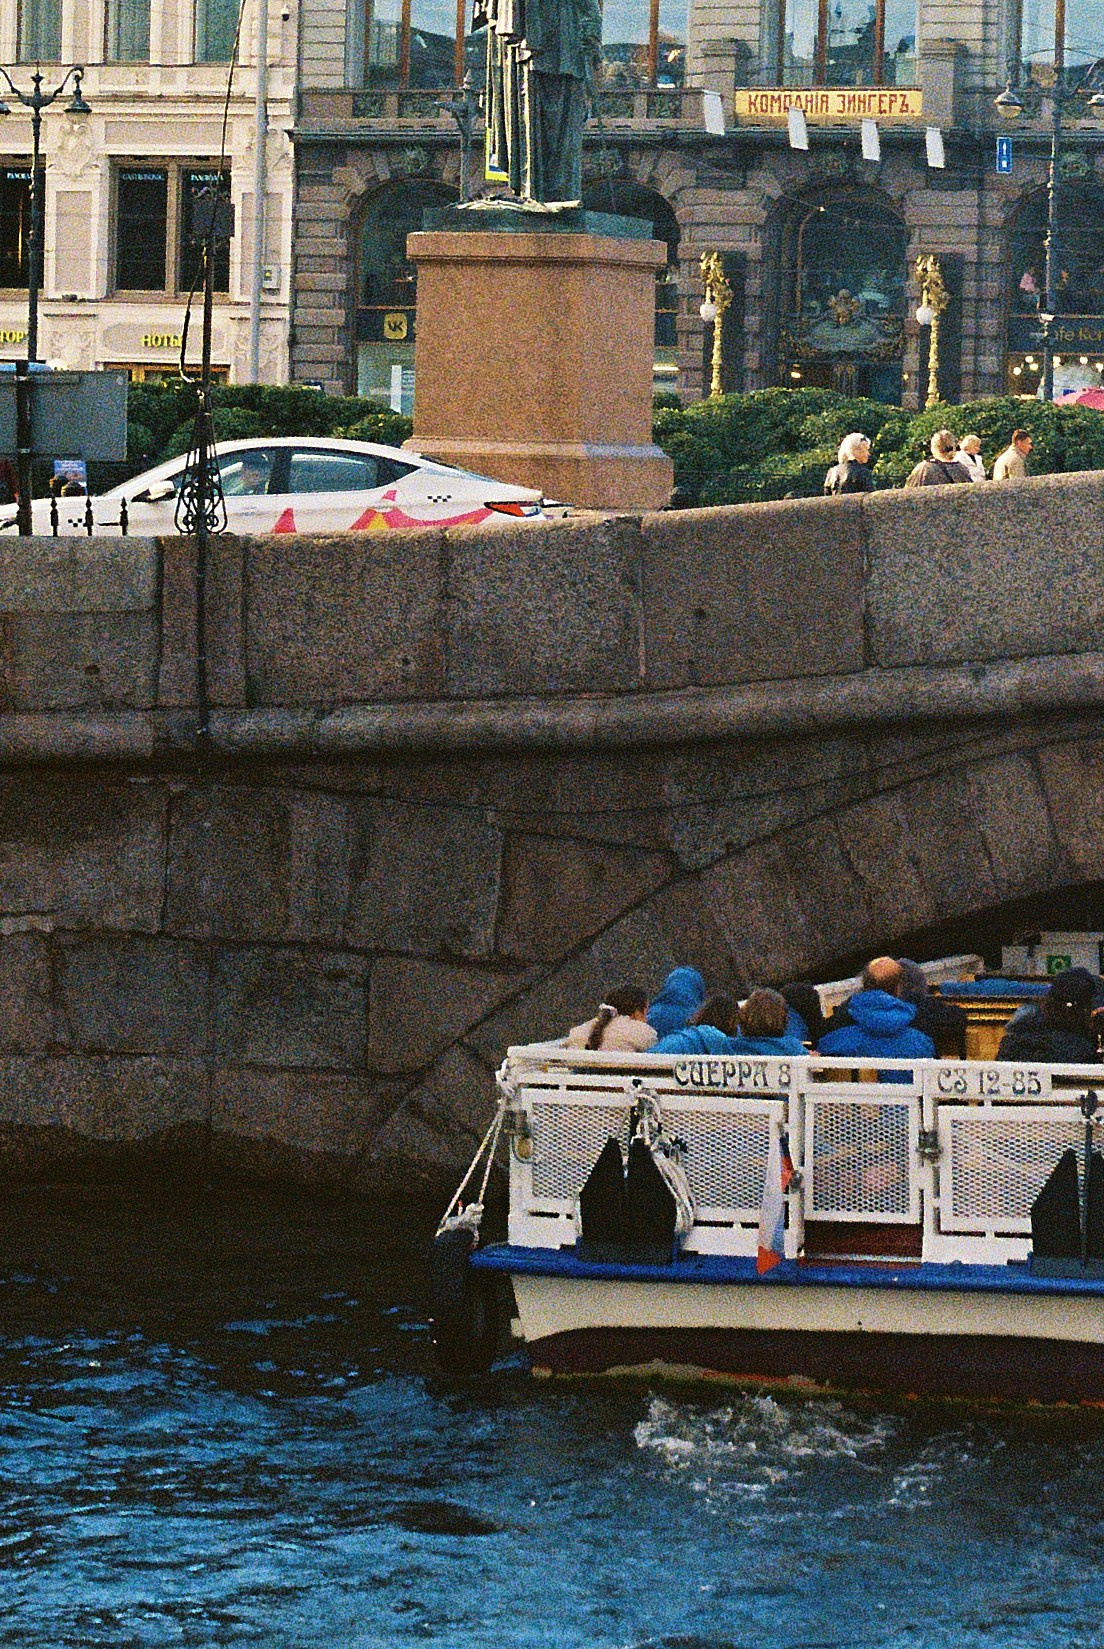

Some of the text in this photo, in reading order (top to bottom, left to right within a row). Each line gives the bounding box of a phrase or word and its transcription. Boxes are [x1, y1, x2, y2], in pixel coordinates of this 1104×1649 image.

[748, 92, 829, 114] КОМПАНІЯ
[778, 1063, 791, 1087] 8
[978, 1070, 1042, 1095] 12-85
